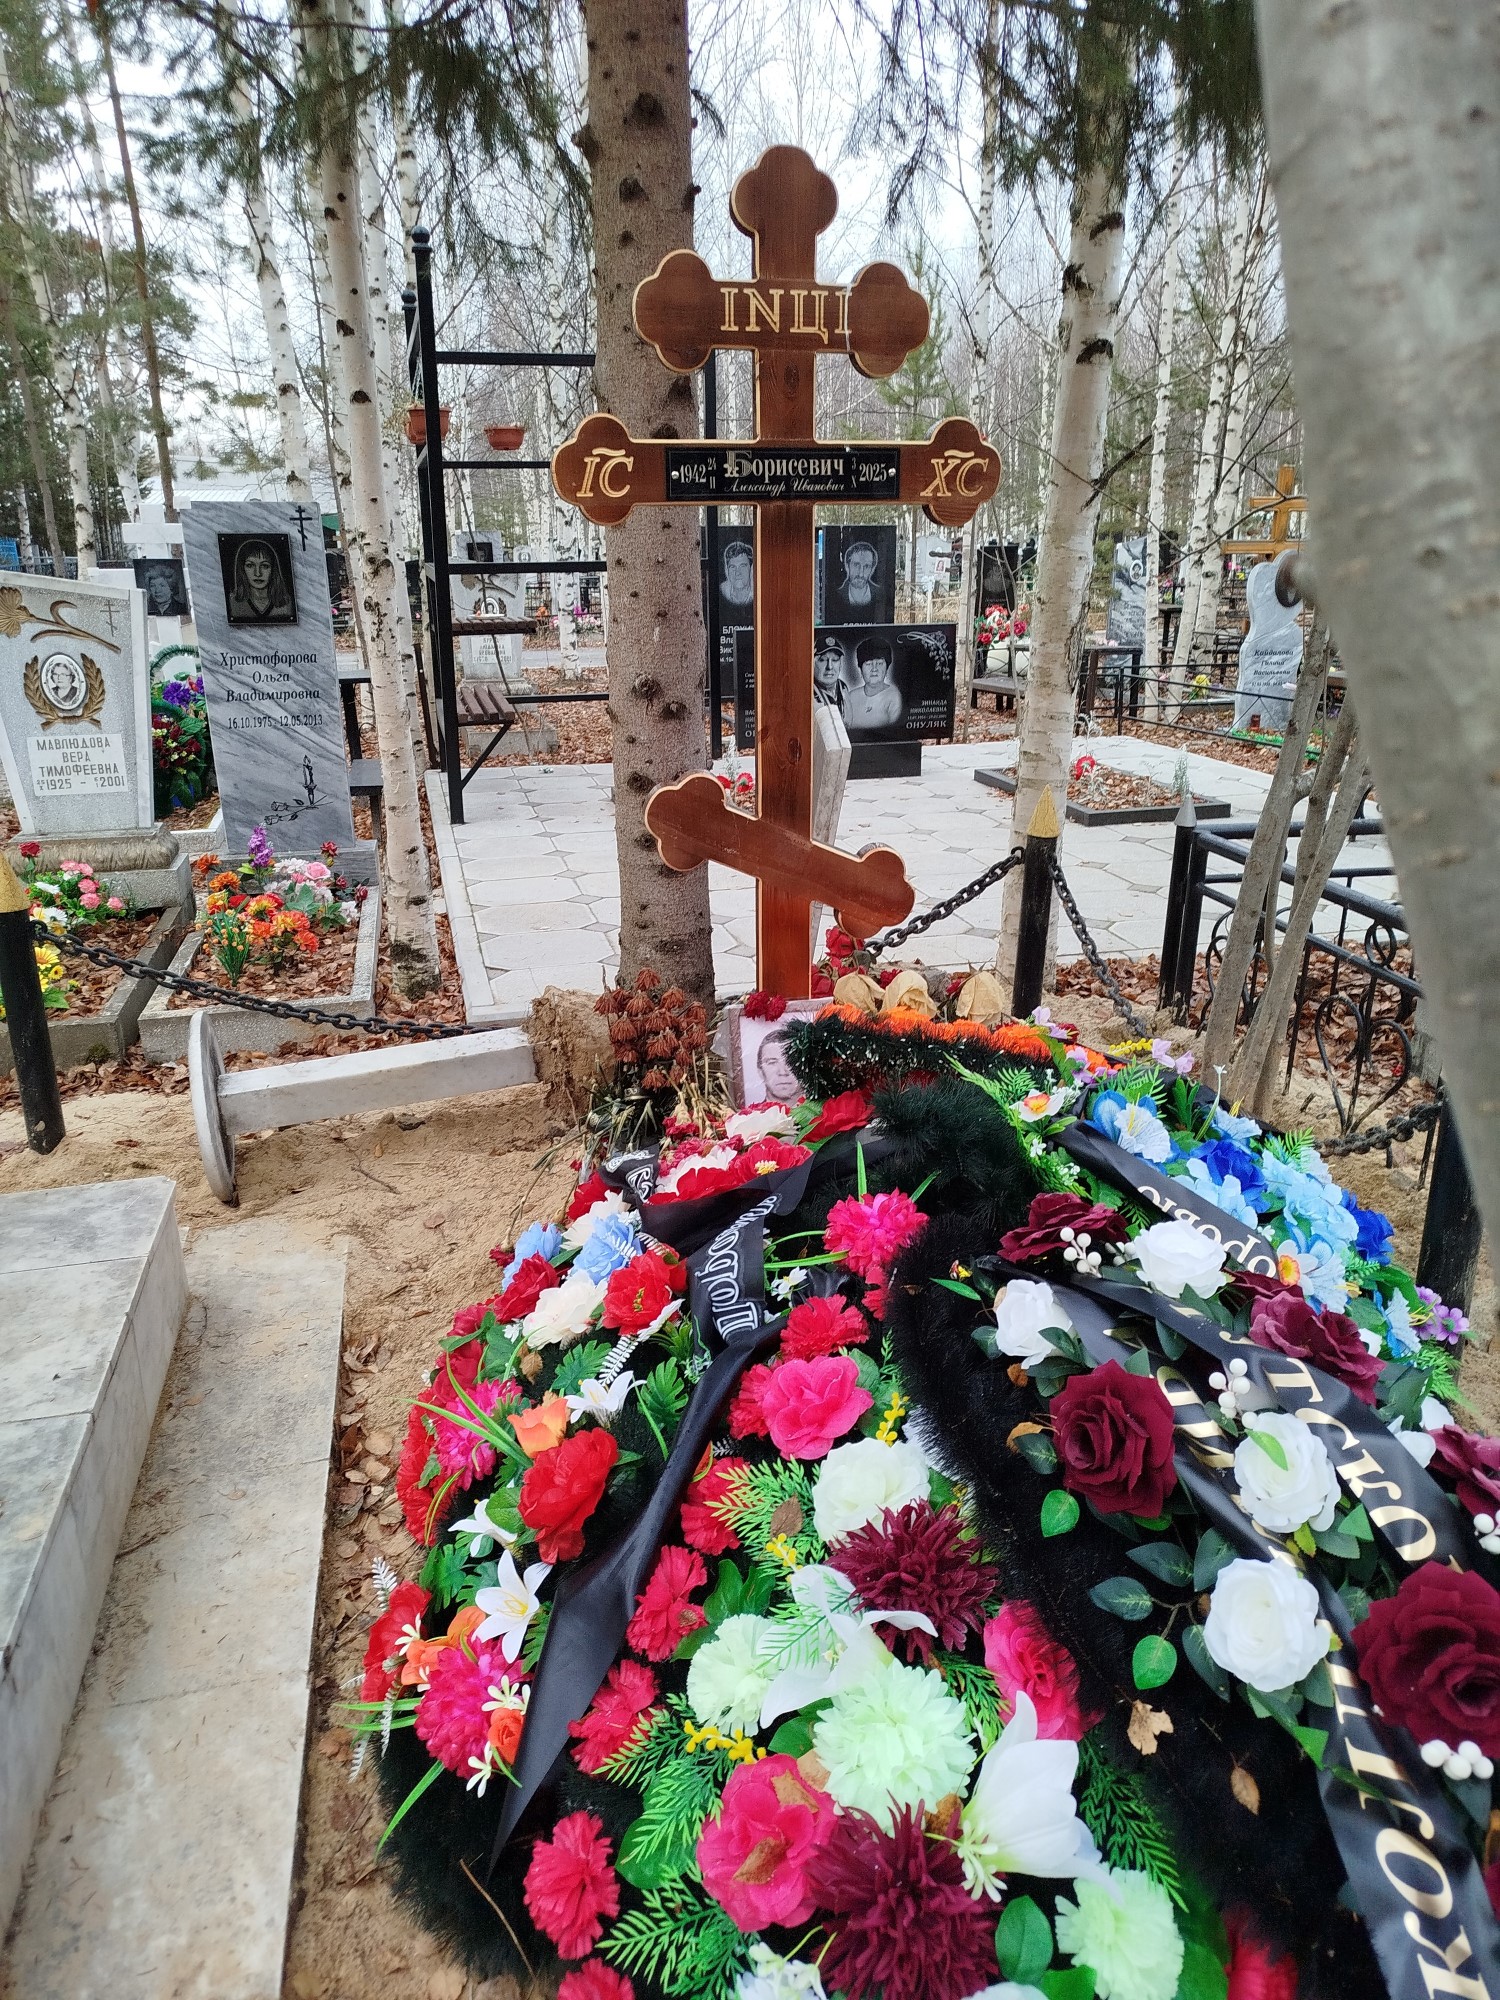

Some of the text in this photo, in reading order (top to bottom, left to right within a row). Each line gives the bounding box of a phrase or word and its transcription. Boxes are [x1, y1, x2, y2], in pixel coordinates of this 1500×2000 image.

[680, 464, 707, 483] 1942
[723, 450, 845, 484] Борисевич
[859, 463, 888, 482] 2025
[723, 478, 845, 498] Александр Иванович
[220, 651, 317, 670] Христофорова
[252, 671, 290, 684] Ольга
[226, 688, 321, 703] Владимировна
[228, 716, 272, 729] 16.10.1975
[280, 714, 323, 727] 12.05.2013
[906, 720, 947, 729] ОНУЛЯК
[36, 737, 111, 751] МАВЛЮДОВА
[62, 751, 91, 763] ВЕРА
[39, 763, 119, 777] ТИМОФЕЕВНА
[46, 779, 72, 790] 1925
[100, 776, 125, 787] 2001
